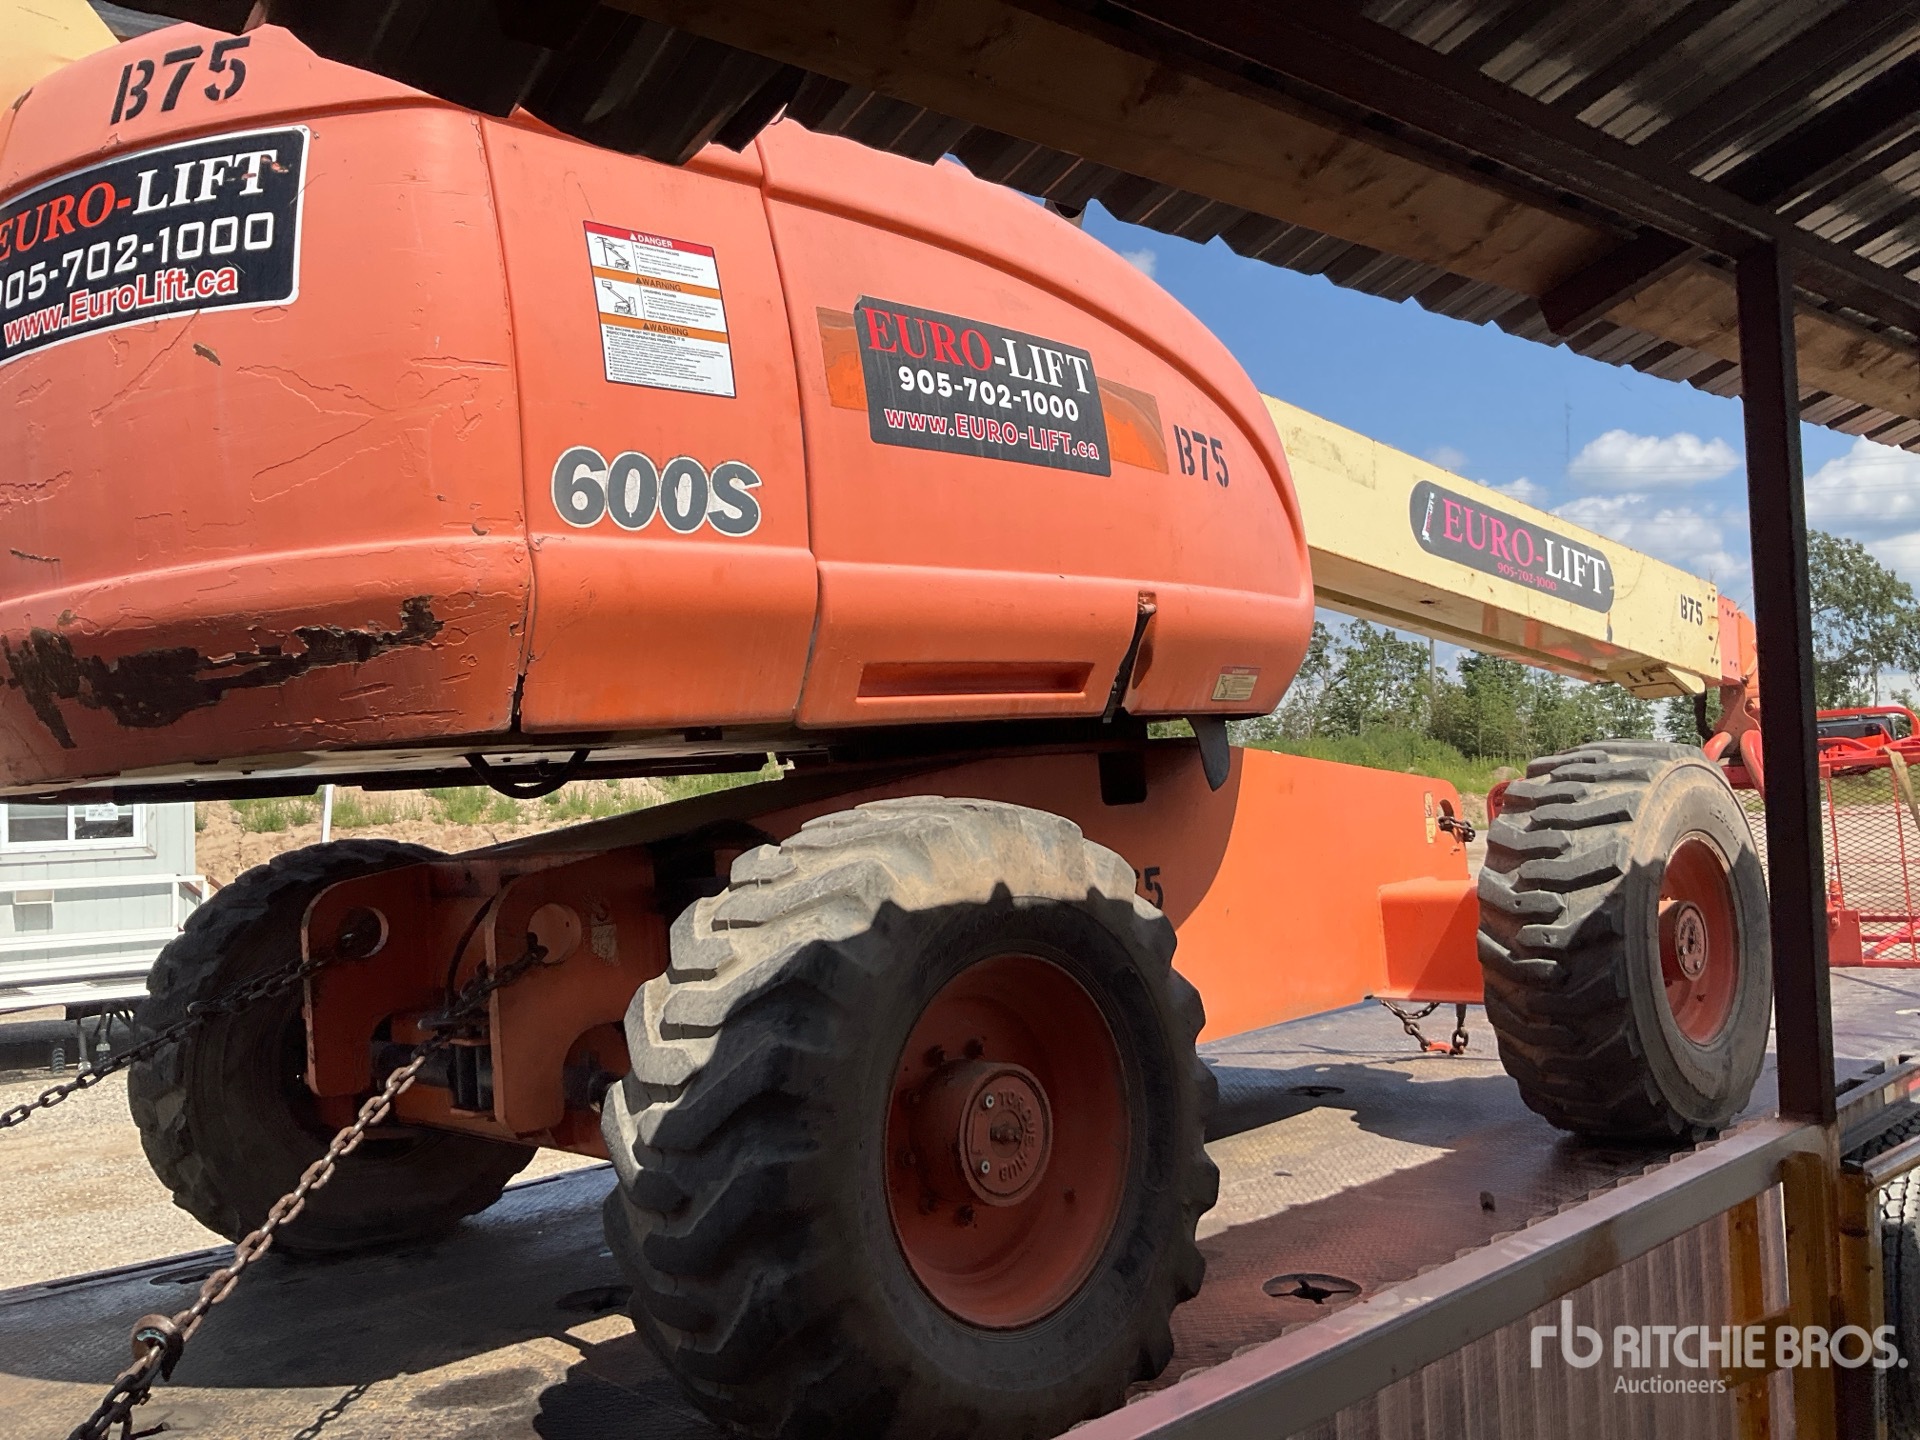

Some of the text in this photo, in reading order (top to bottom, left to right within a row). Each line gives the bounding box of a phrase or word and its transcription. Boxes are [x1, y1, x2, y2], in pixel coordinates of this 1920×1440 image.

[110, 36, 251, 125] B75
[0, 212, 274, 310] 05-702-1000
[637, 234, 673, 249] DANGER
[3, 266, 238, 348] www.EuroLift.ca
[641, 277, 682, 292] WARNING
[649, 324, 689, 336] WARNING
[860, 306, 1091, 394] EURO-LIFT
[898, 366, 1079, 422] 905-702-1000
[884, 408, 1100, 461] www.EURO-LIFT.ca
[1174, 424, 1230, 488] B75
[551, 445, 762, 537] 600S
[1442, 497, 1606, 594] EURO-LIFT
[1497, 561, 1557, 591] 905-702-1000
[1680, 593, 1703, 625] B75
[1134, 866, 1164, 910] 5
